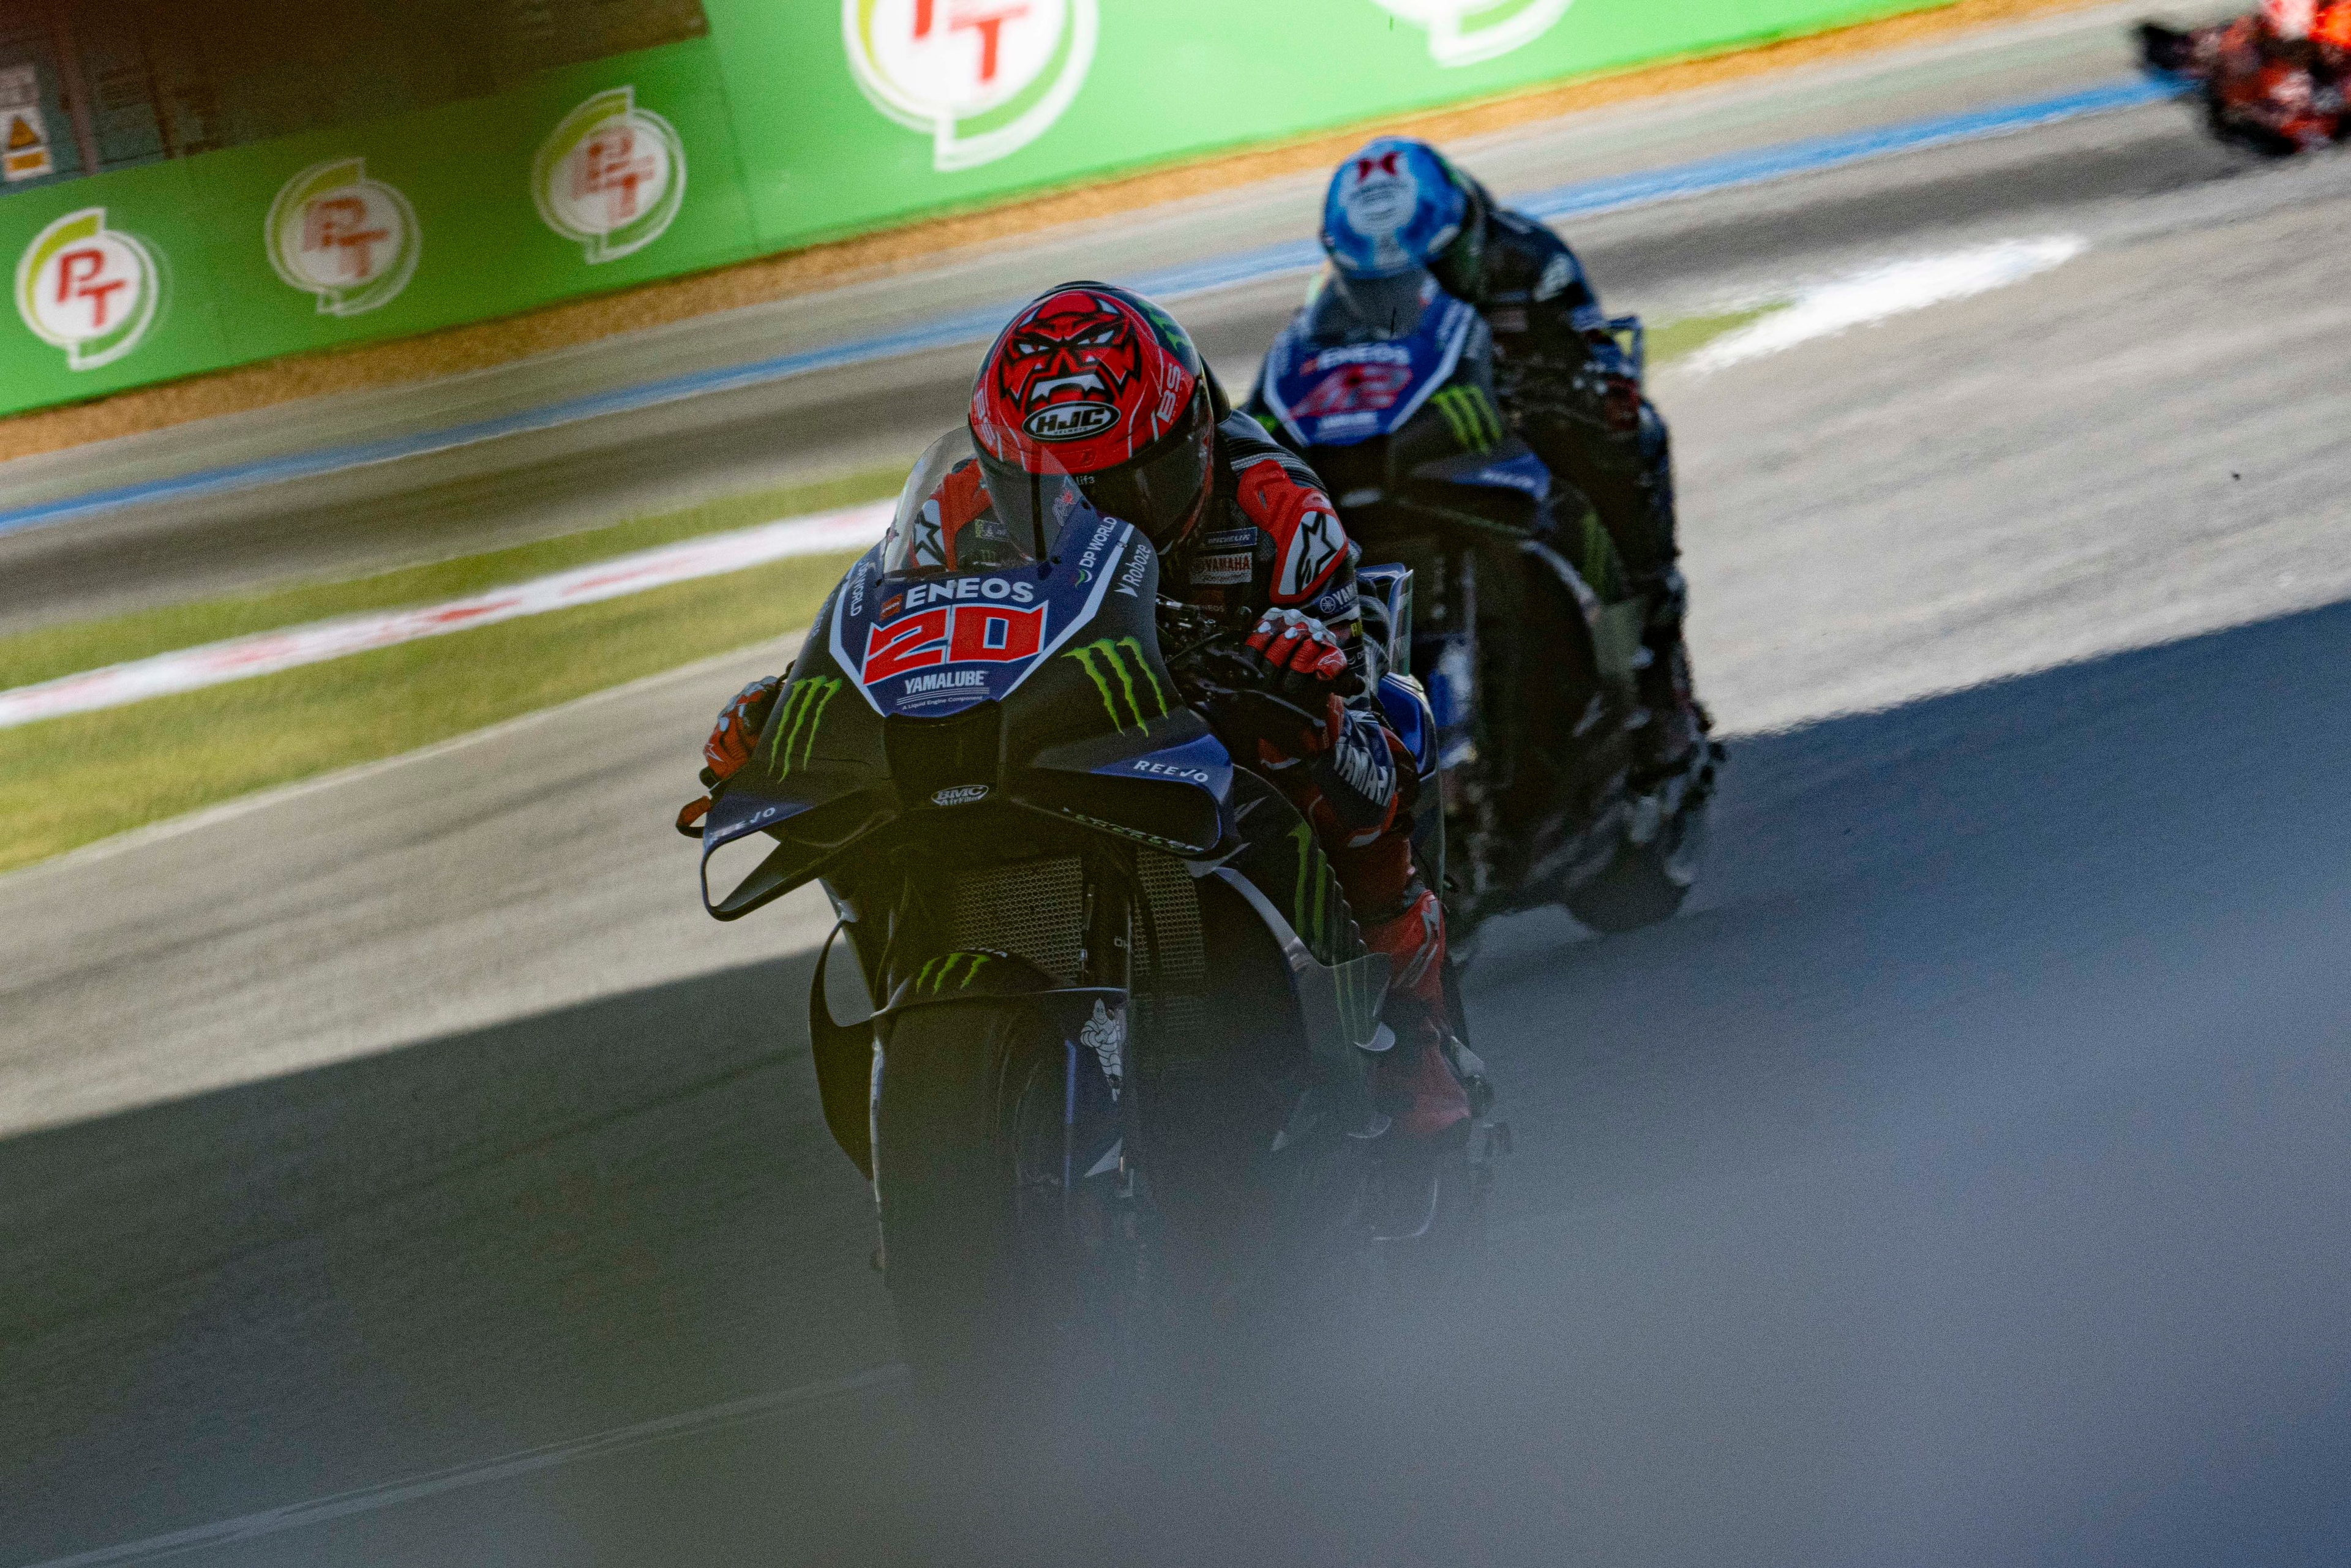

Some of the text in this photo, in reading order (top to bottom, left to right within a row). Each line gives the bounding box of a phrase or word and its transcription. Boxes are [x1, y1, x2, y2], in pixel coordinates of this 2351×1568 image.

[56, 249, 127, 328] PT
[1157, 362, 1181, 422] BS
[1036, 407, 1106, 433] HJC
[1079, 516, 1118, 569] DP WORLD
[1122, 544, 1151, 587] Roboze
[1204, 555, 1250, 571] YAMAHA
[905, 577, 1034, 610] ENEOS
[861, 599, 1049, 687] 20
[904, 670, 987, 695] YAMALUBE
[909, 701, 926, 710] Liquid
[937, 786, 983, 800] BMC
